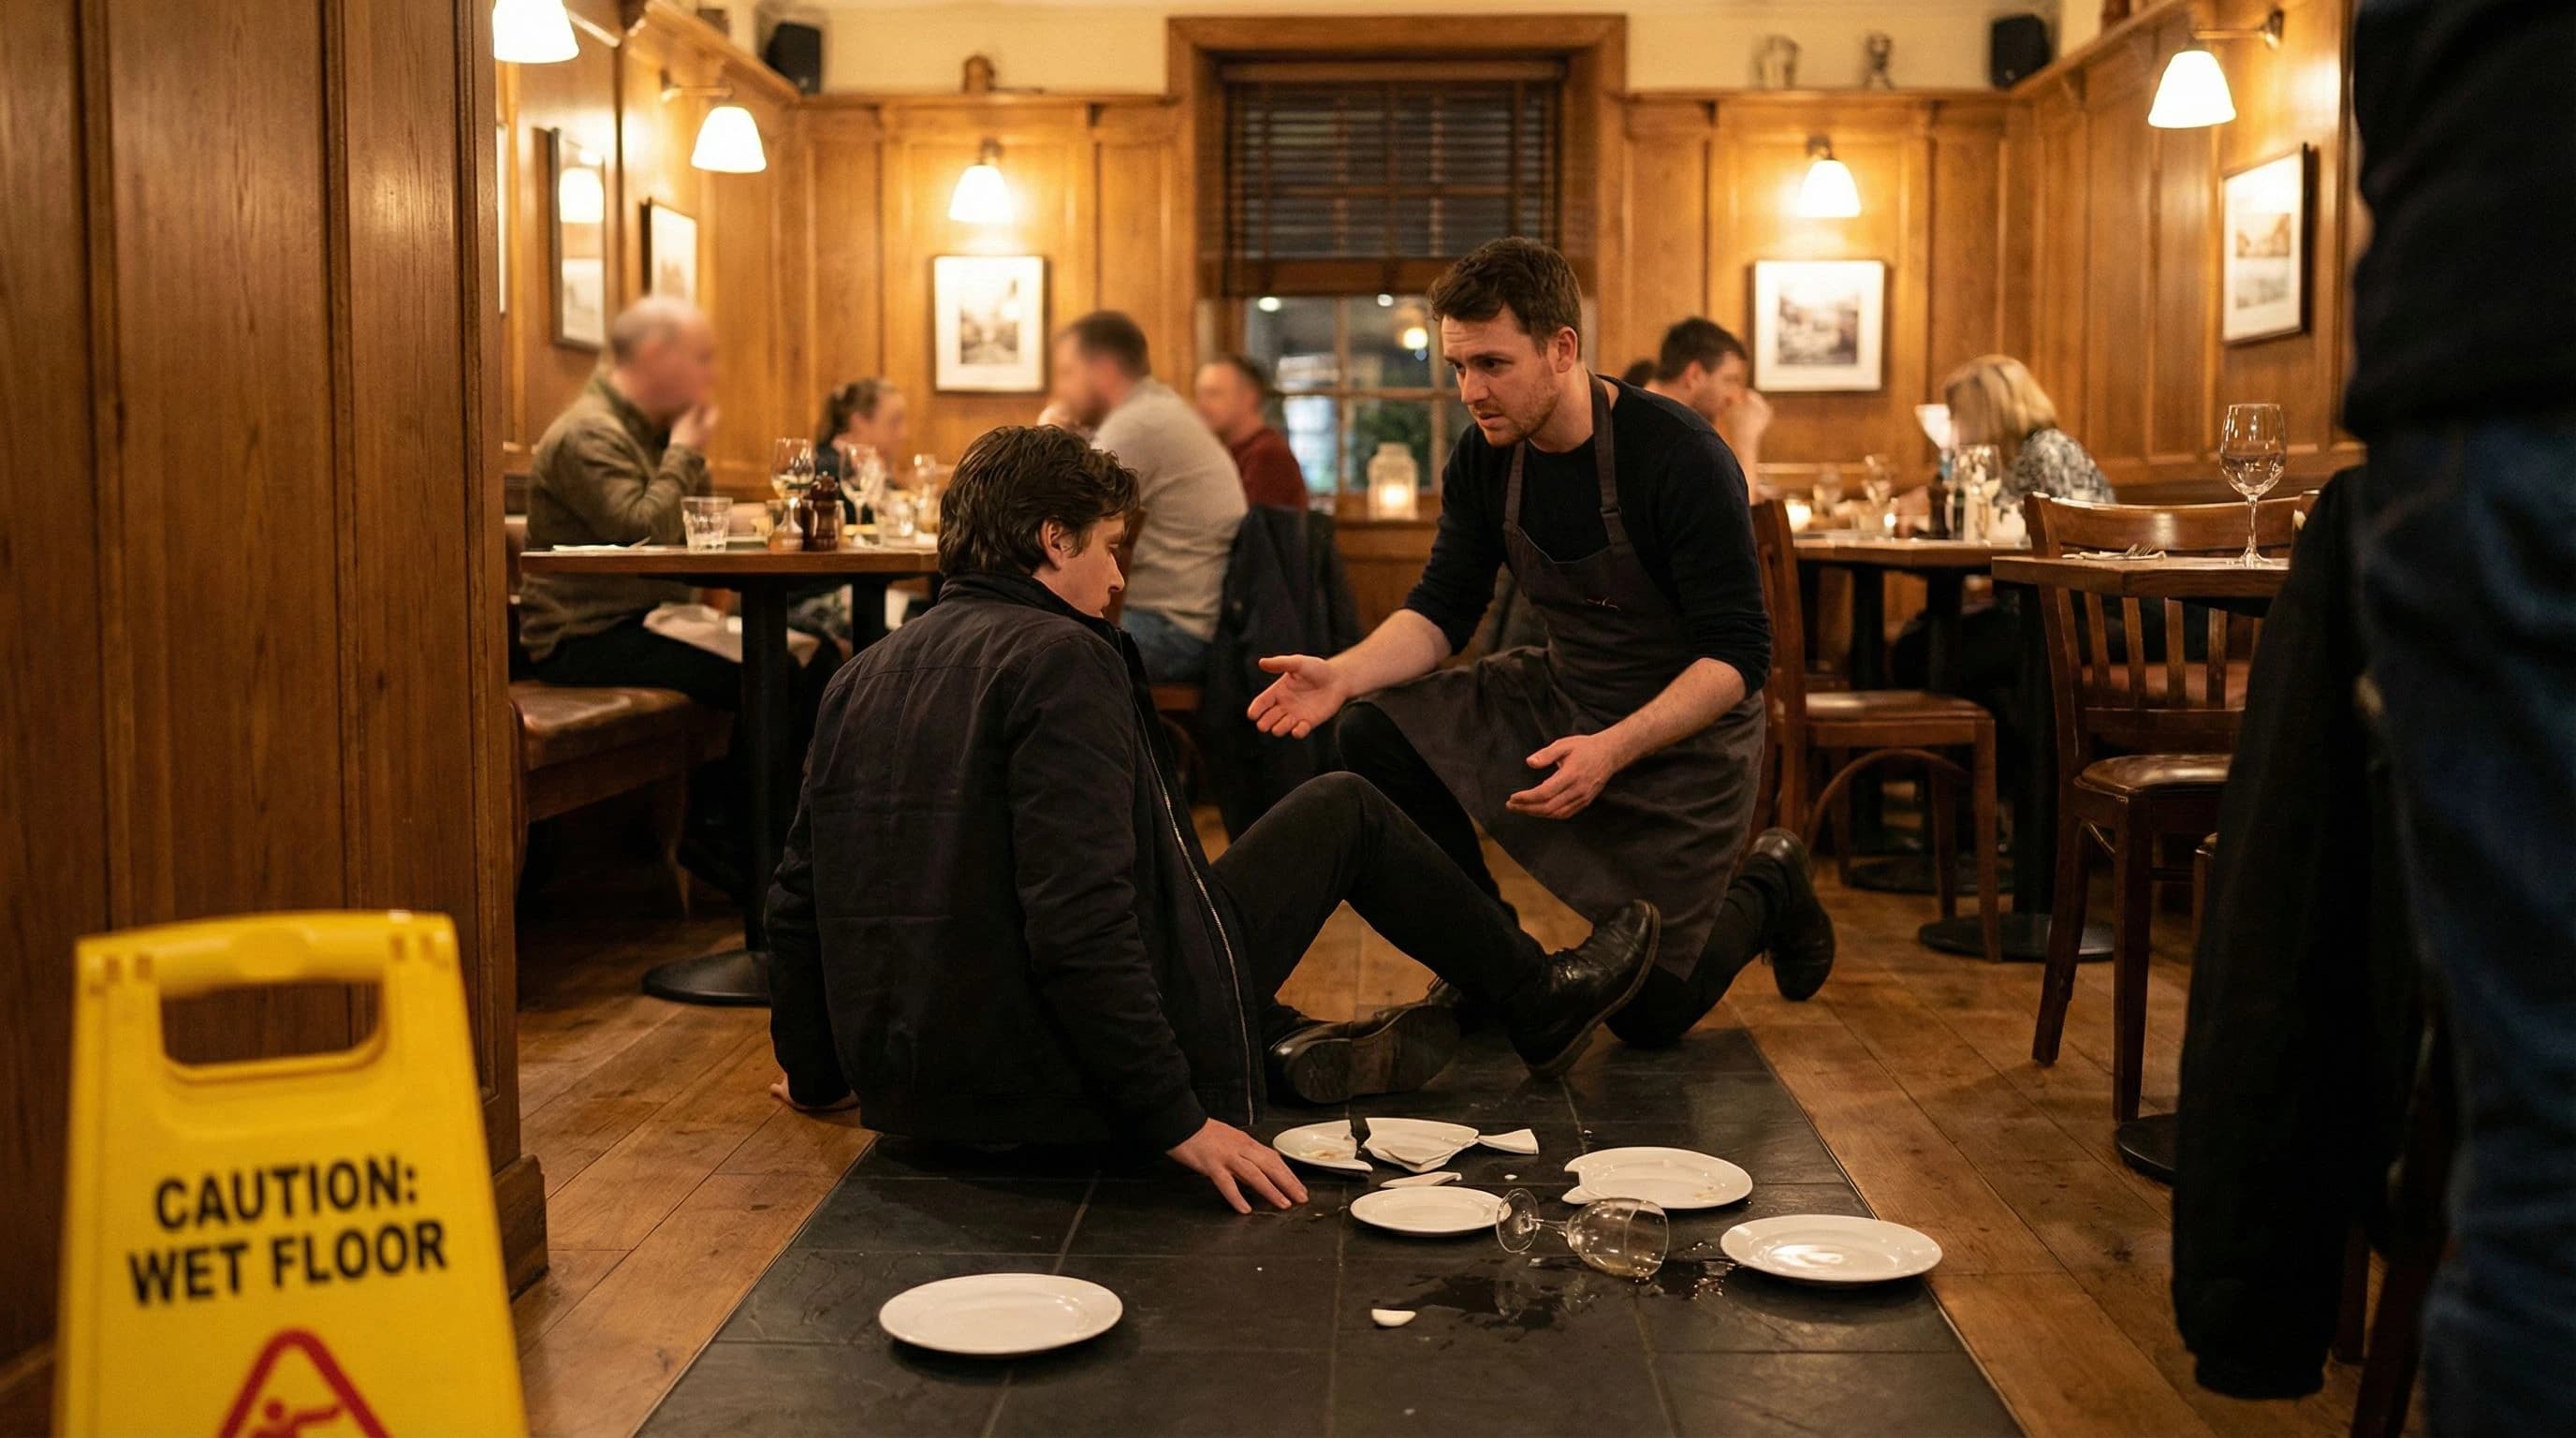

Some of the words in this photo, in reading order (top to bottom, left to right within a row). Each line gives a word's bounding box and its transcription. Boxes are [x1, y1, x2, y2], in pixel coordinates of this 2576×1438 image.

[154, 1155, 417, 1232] CAUTION:
[127, 1241, 250, 1307] WET
[271, 1220, 448, 1288] FLOOR
